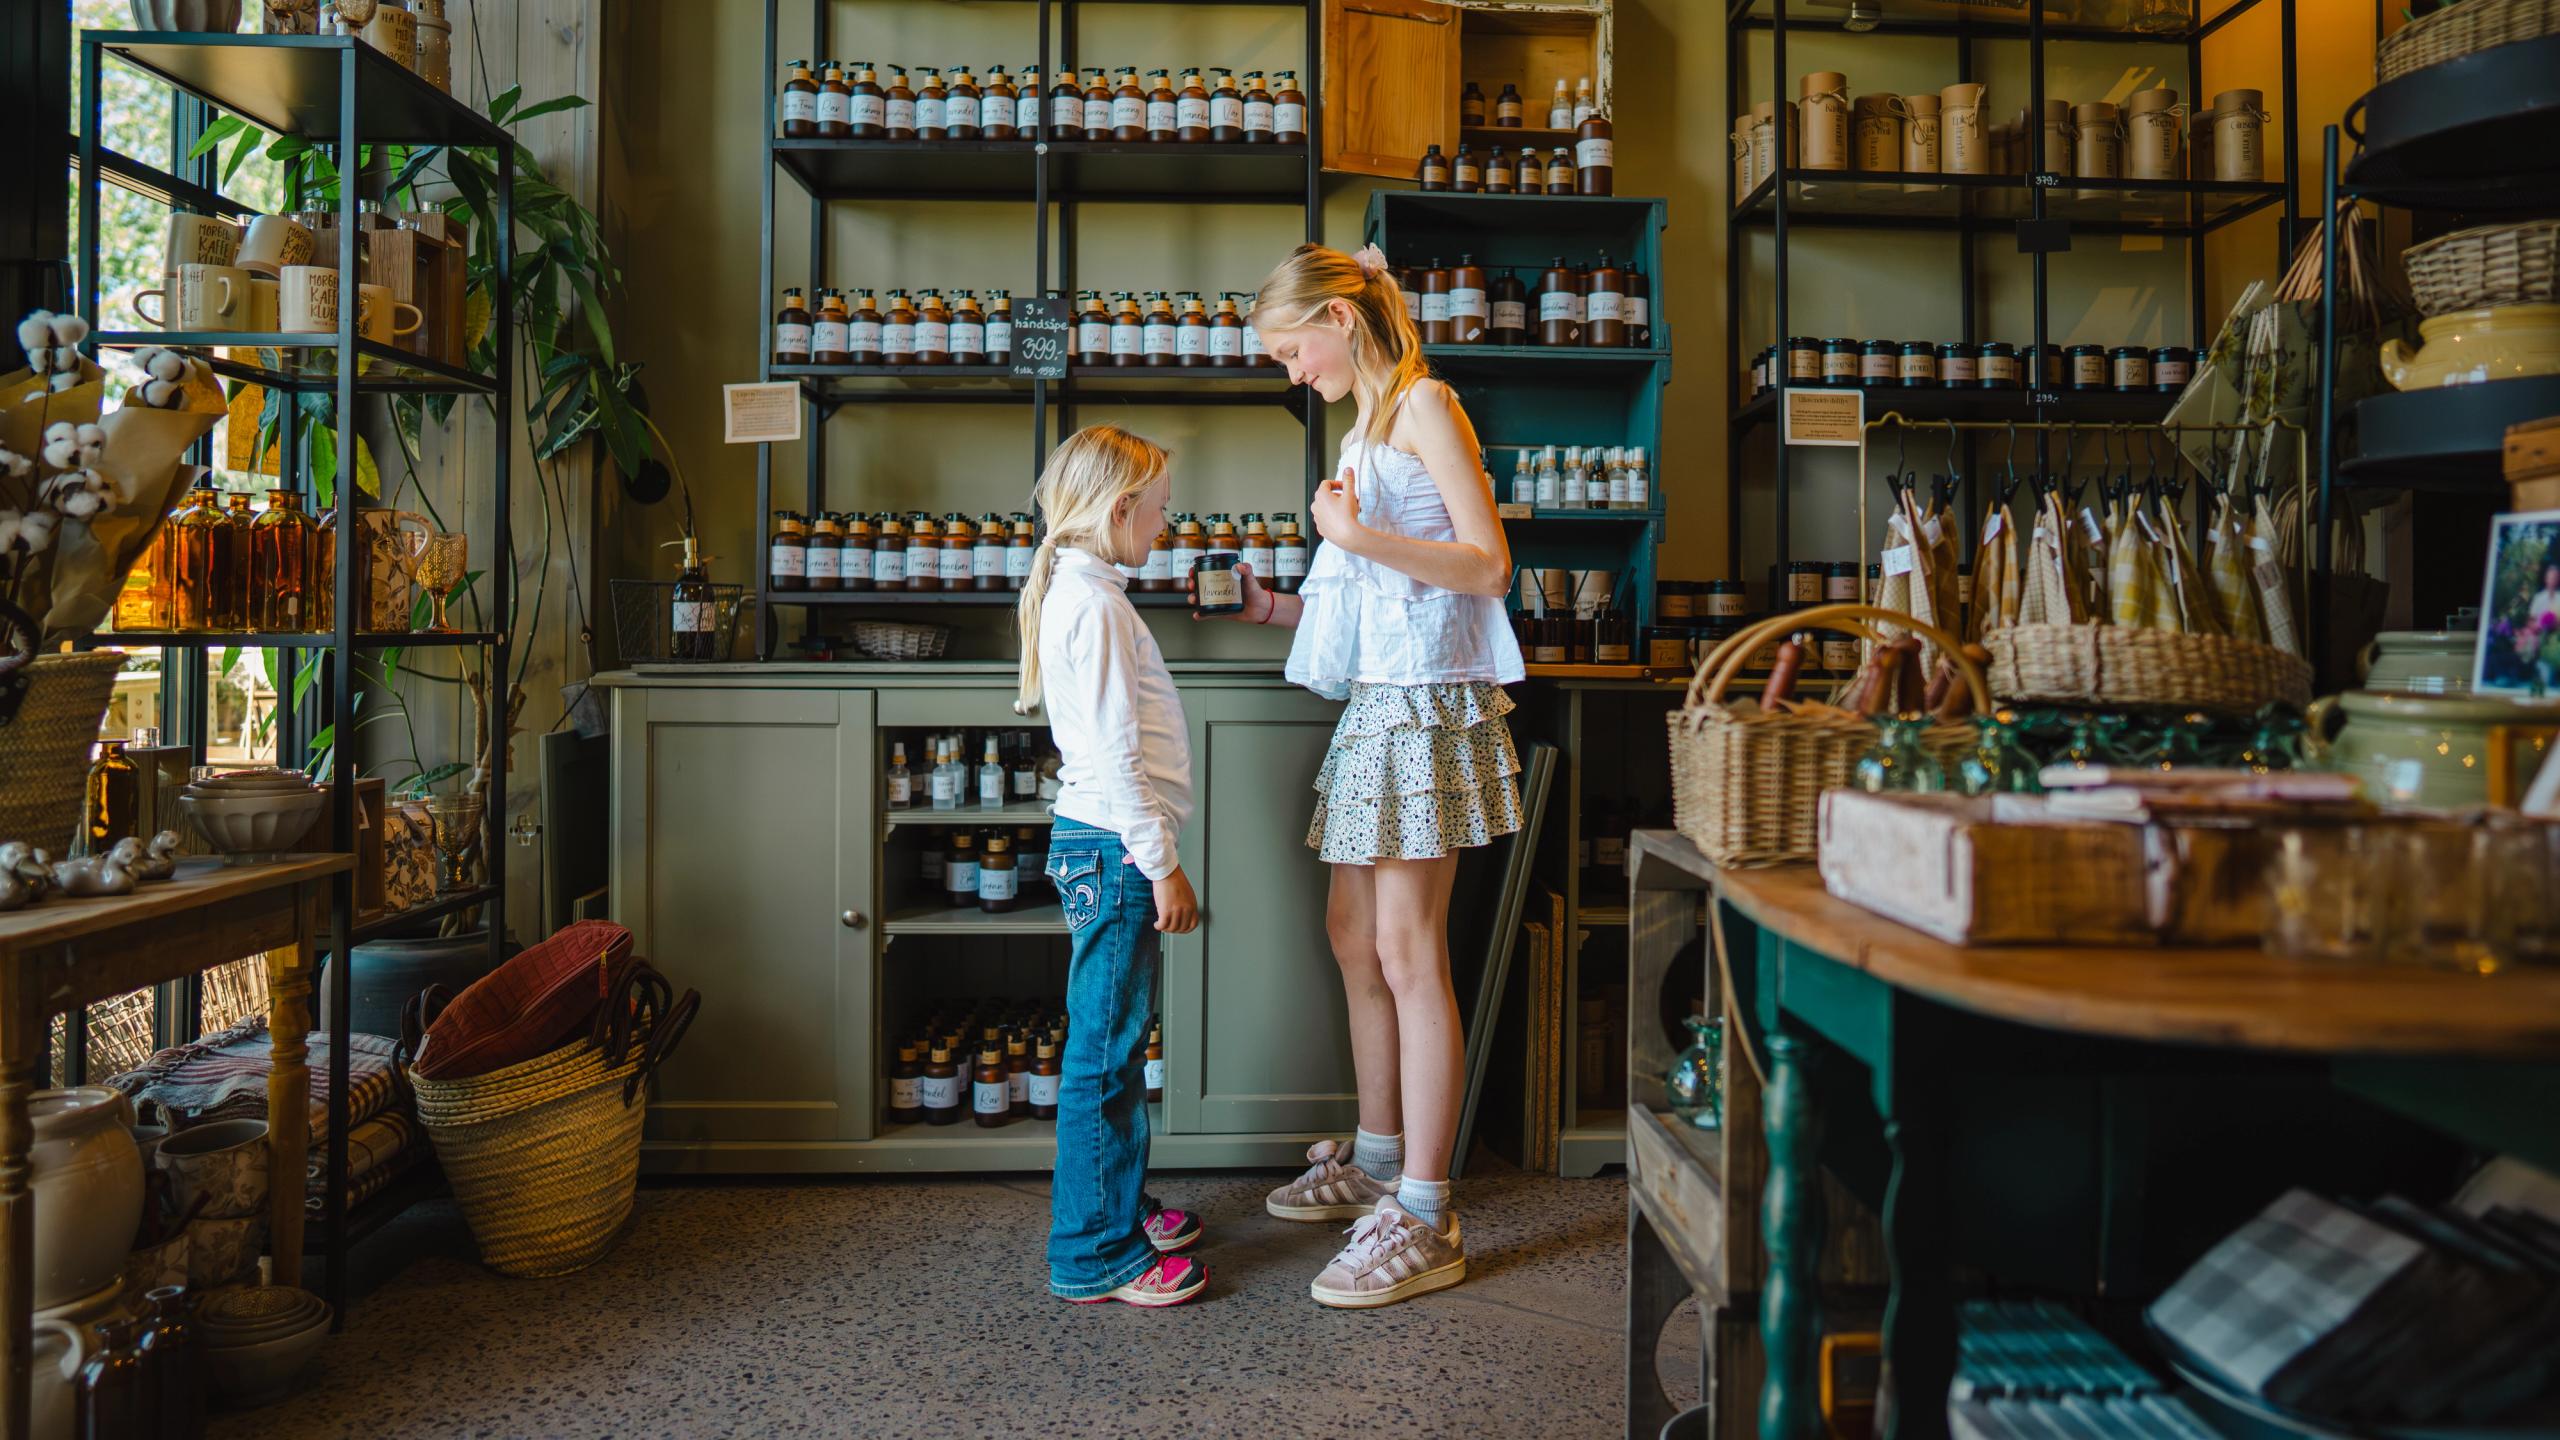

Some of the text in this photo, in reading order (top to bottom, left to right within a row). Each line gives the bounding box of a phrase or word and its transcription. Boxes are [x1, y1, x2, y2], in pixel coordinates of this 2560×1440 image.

[309, 274, 338, 289] MORGE
[310, 287, 338, 305] KAFF
[1025, 303, 1034, 315] 3
[979, 1090, 1001, 1107] Rav
